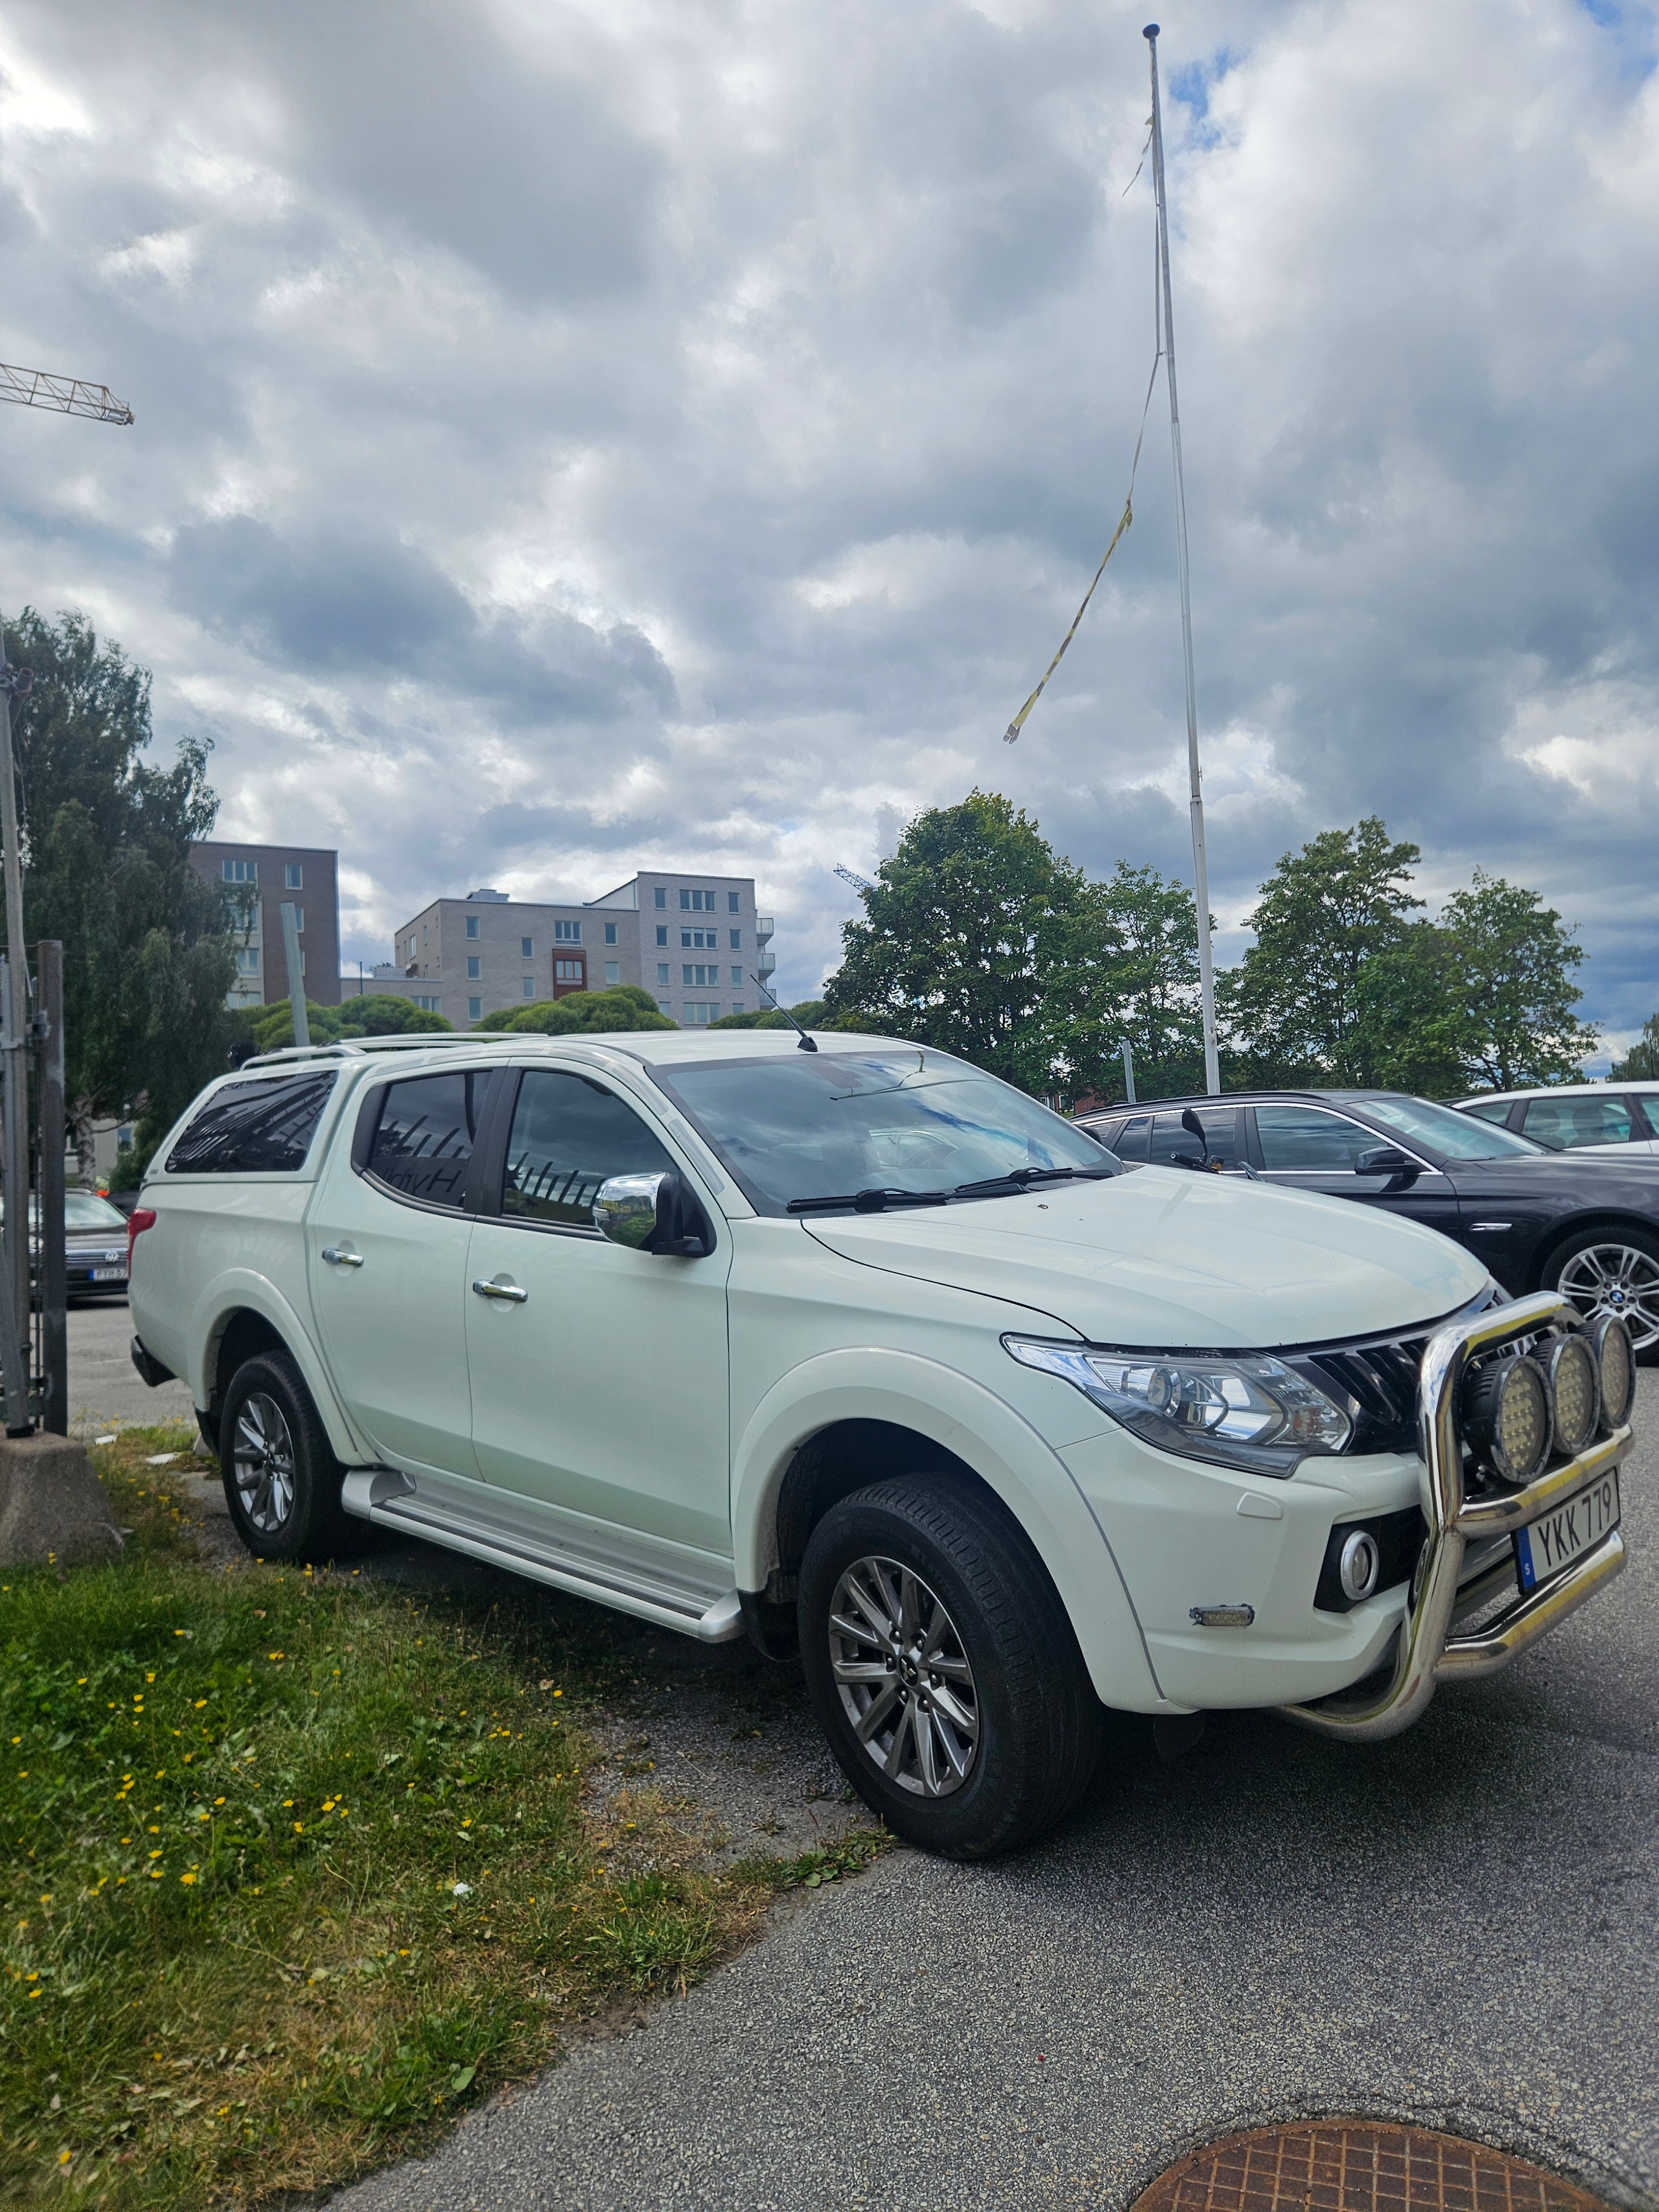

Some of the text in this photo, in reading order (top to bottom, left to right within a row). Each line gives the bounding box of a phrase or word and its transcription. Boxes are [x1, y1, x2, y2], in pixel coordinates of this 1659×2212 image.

[1537, 1480, 1611, 1568] YKK 779
[1525, 1562, 1531, 1576] S
